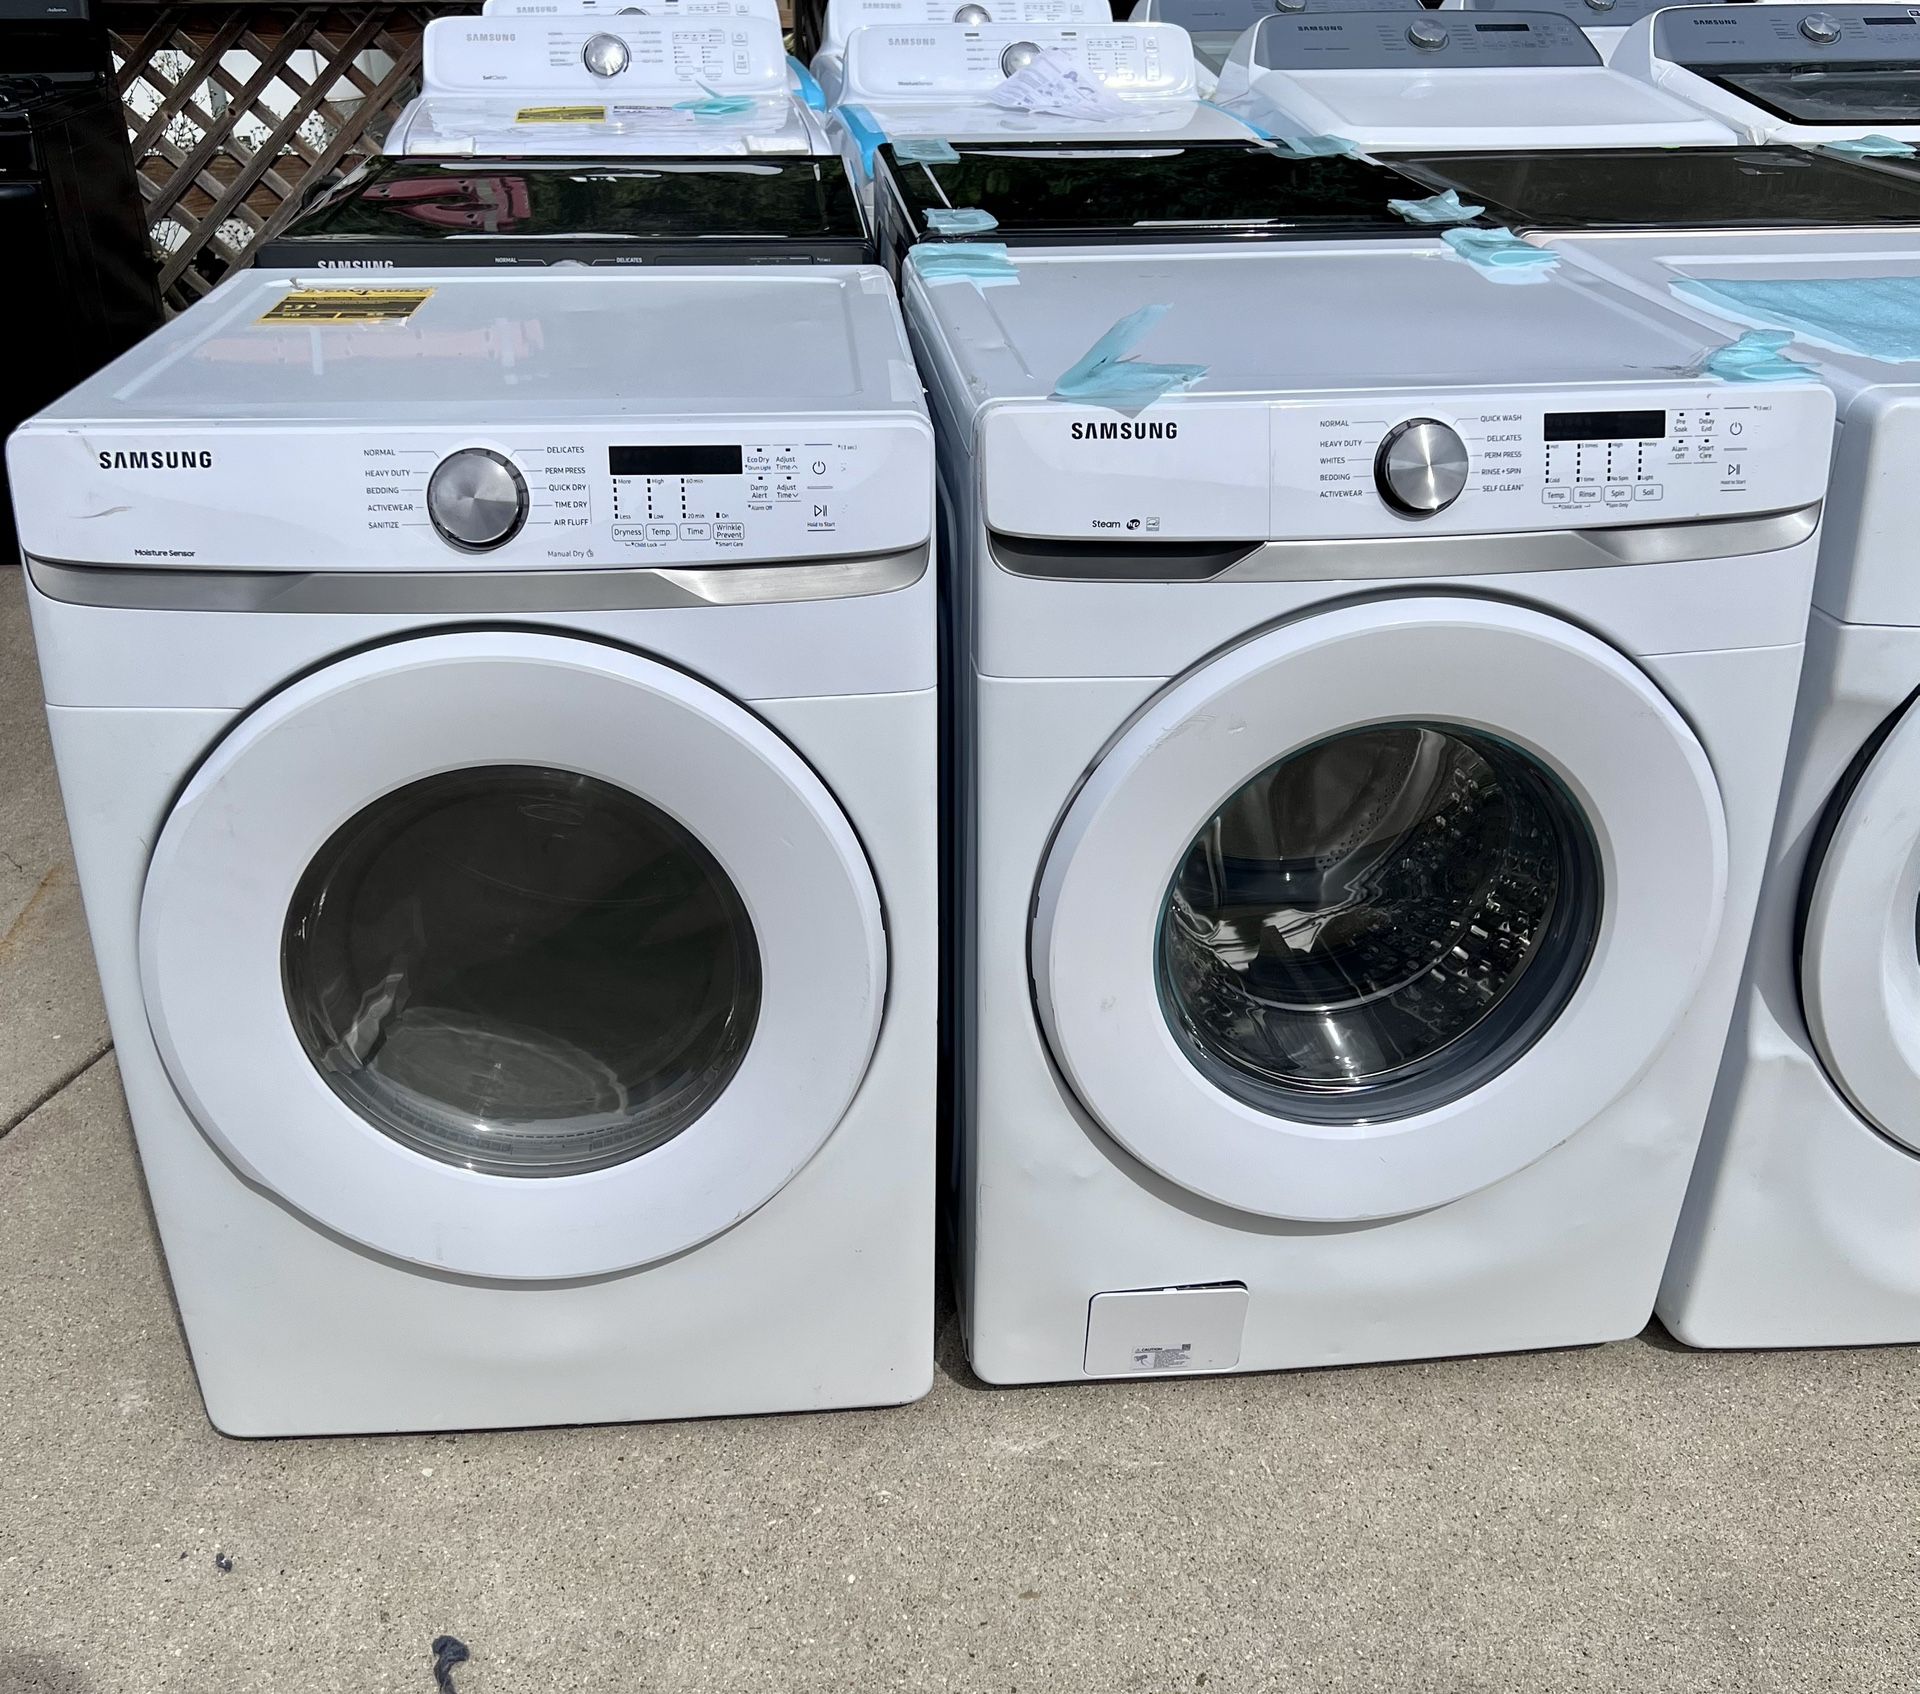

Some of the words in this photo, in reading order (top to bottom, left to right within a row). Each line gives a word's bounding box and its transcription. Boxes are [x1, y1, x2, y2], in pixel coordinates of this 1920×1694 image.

[466, 34, 516, 42] SAMSUNG
[318, 260, 394, 268] SAMSUNG
[1072, 422, 1178, 439] SAMSUNG
[100, 450, 212, 470] SAMSUNG
[1092, 520, 1120, 528] Steam
[614, 528, 642, 537] Dryness
